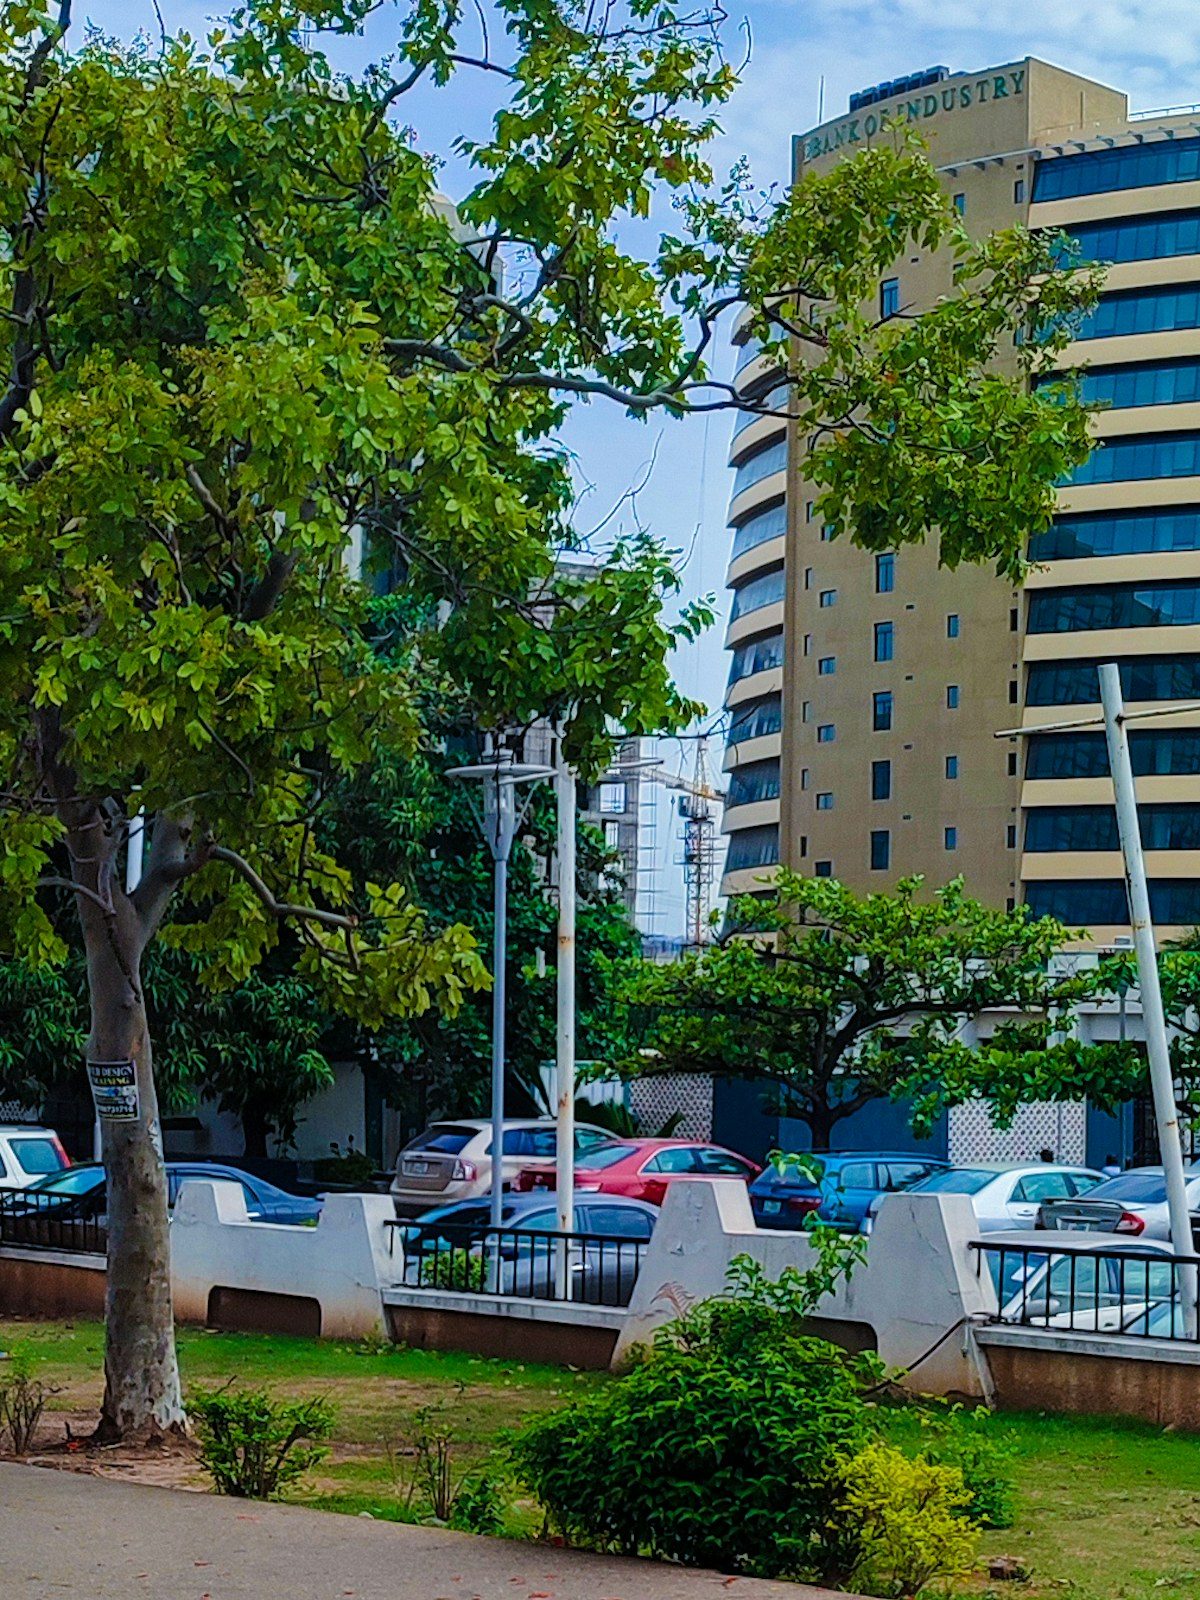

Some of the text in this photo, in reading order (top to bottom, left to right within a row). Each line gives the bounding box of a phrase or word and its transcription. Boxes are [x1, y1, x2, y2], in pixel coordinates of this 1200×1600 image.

[804, 70, 1025, 165] BANK OF INDUSTRY
[101, 1065, 133, 1076] DESIGN
